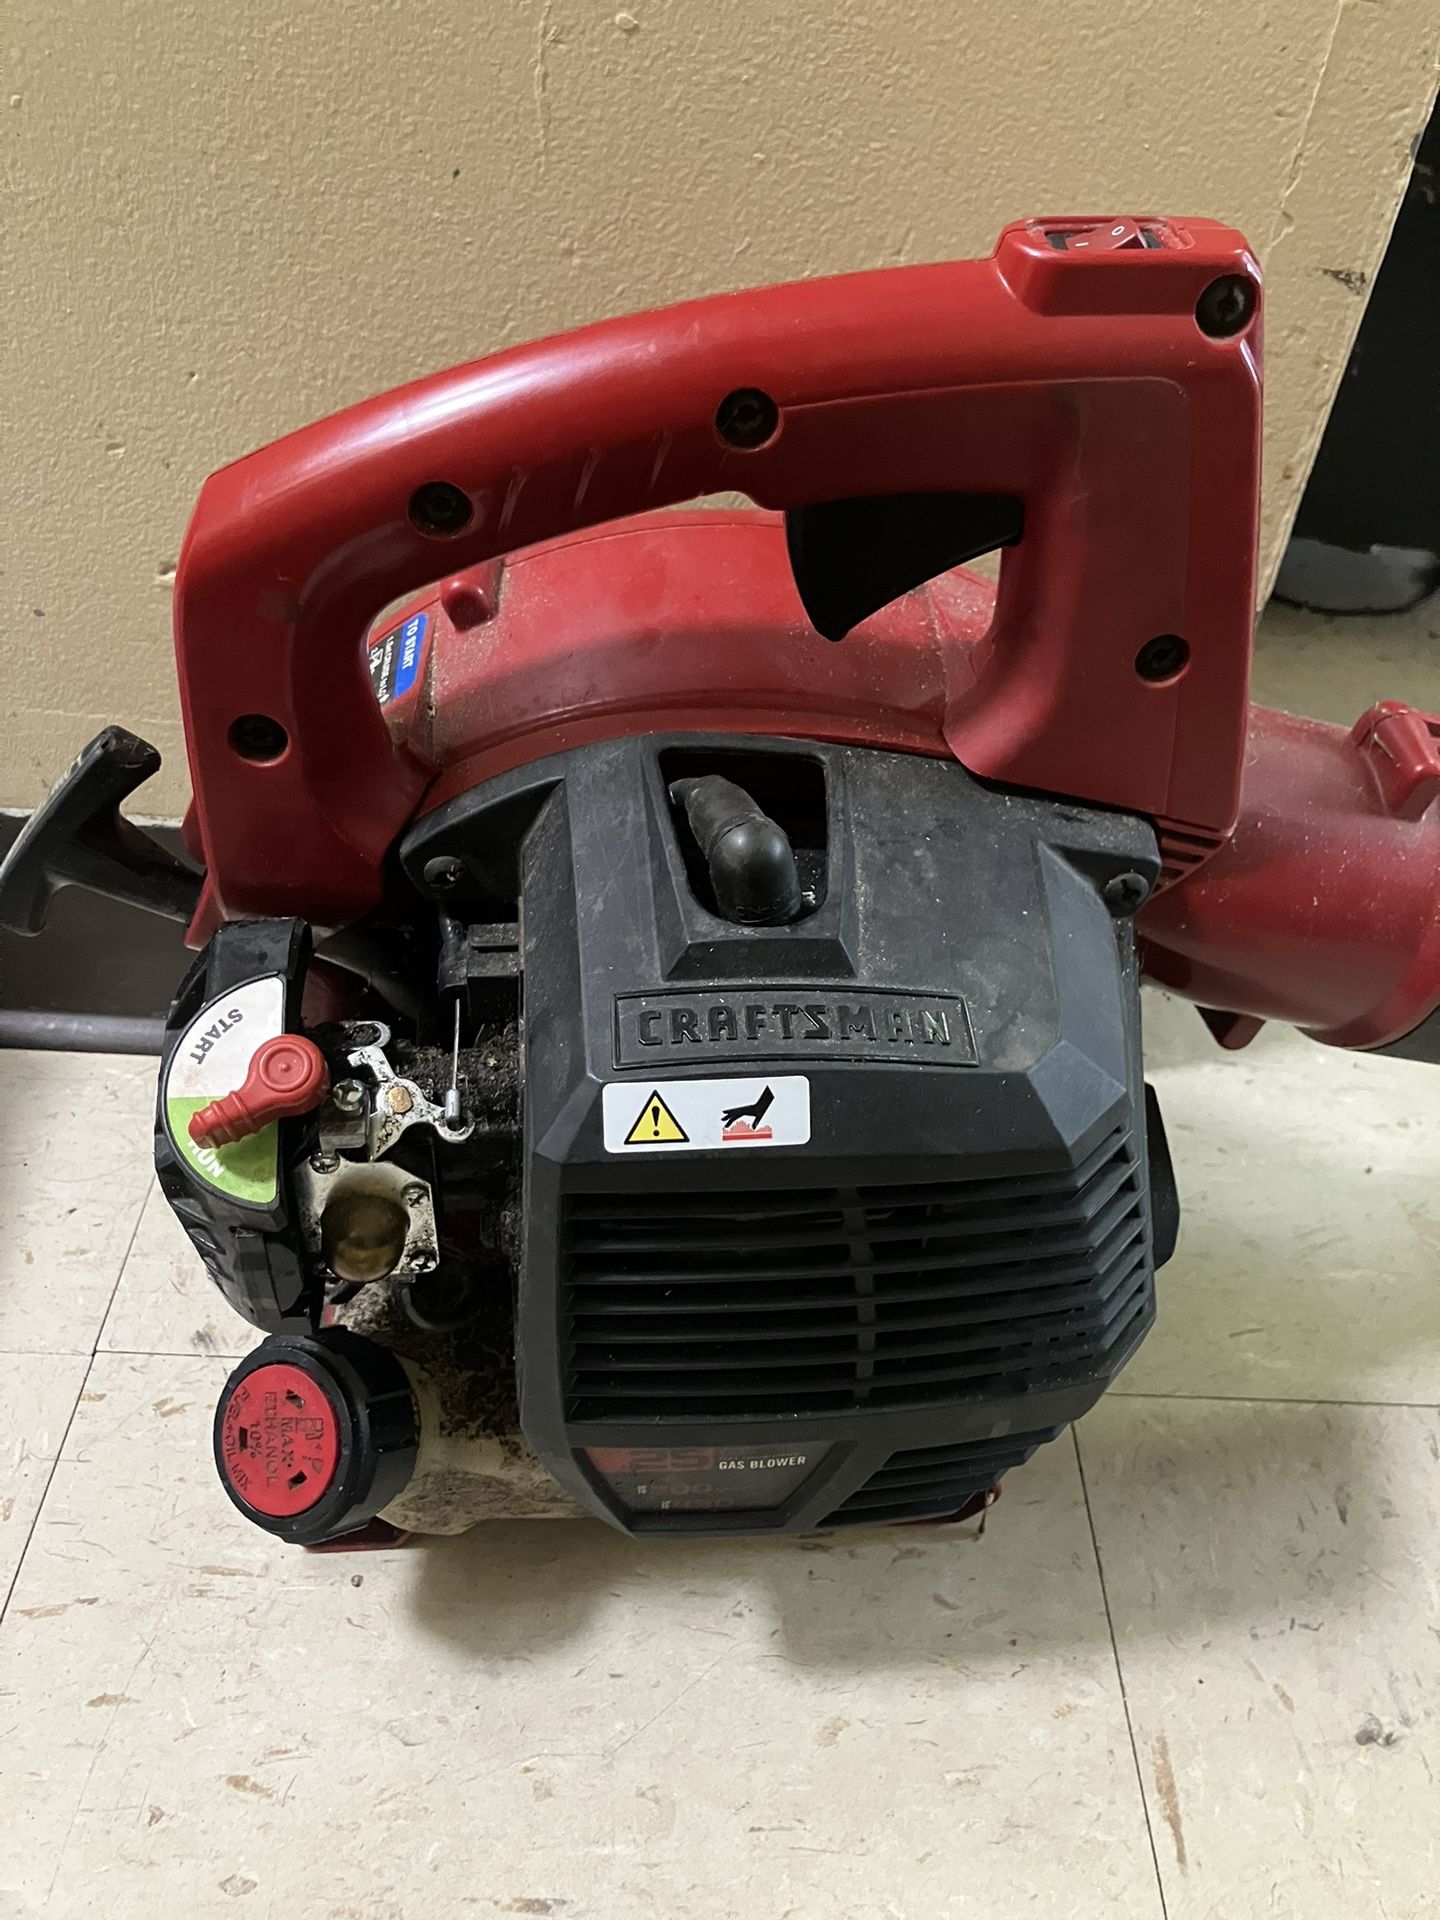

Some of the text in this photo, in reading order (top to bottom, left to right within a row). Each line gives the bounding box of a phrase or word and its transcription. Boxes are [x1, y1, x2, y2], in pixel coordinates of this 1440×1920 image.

[402, 618, 419, 669] TO START
[190, 1008, 243, 1064] START
[638, 1004, 951, 1046] CRAFTSMAN
[264, 1391, 279, 1487] ETHANOL
[718, 1460, 745, 1471] GAS
[750, 1456, 807, 1469] BLOWER
